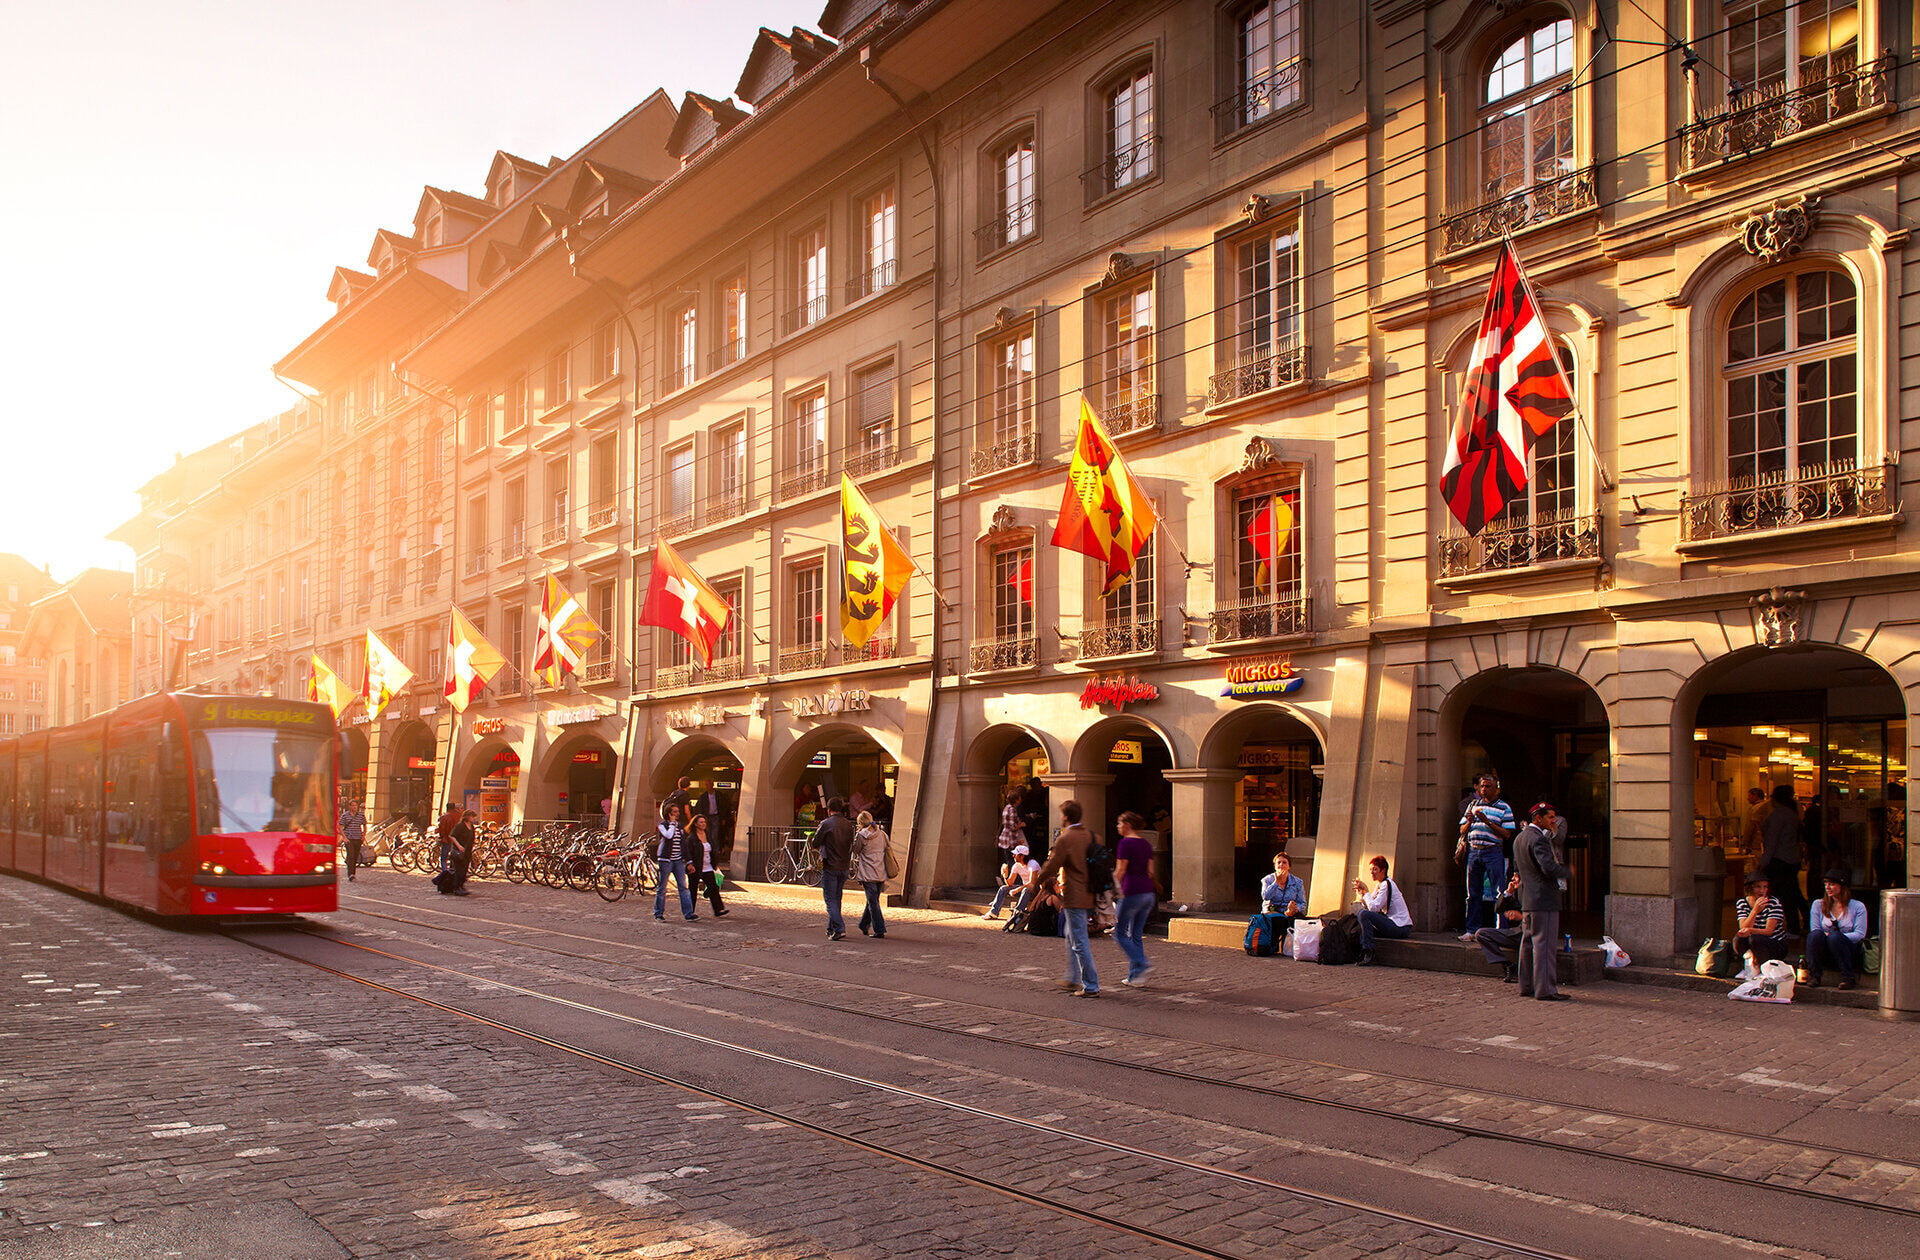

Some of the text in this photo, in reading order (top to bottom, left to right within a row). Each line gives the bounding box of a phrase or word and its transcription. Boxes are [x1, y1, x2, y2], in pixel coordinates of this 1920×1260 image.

[1225, 661, 1294, 684] MIGROS
[1079, 675, 1157, 711] Hotelplan
[1231, 682, 1287, 695] Take Away
[204, 702, 217, 721] 9
[472, 717, 503, 734] MIGROS
